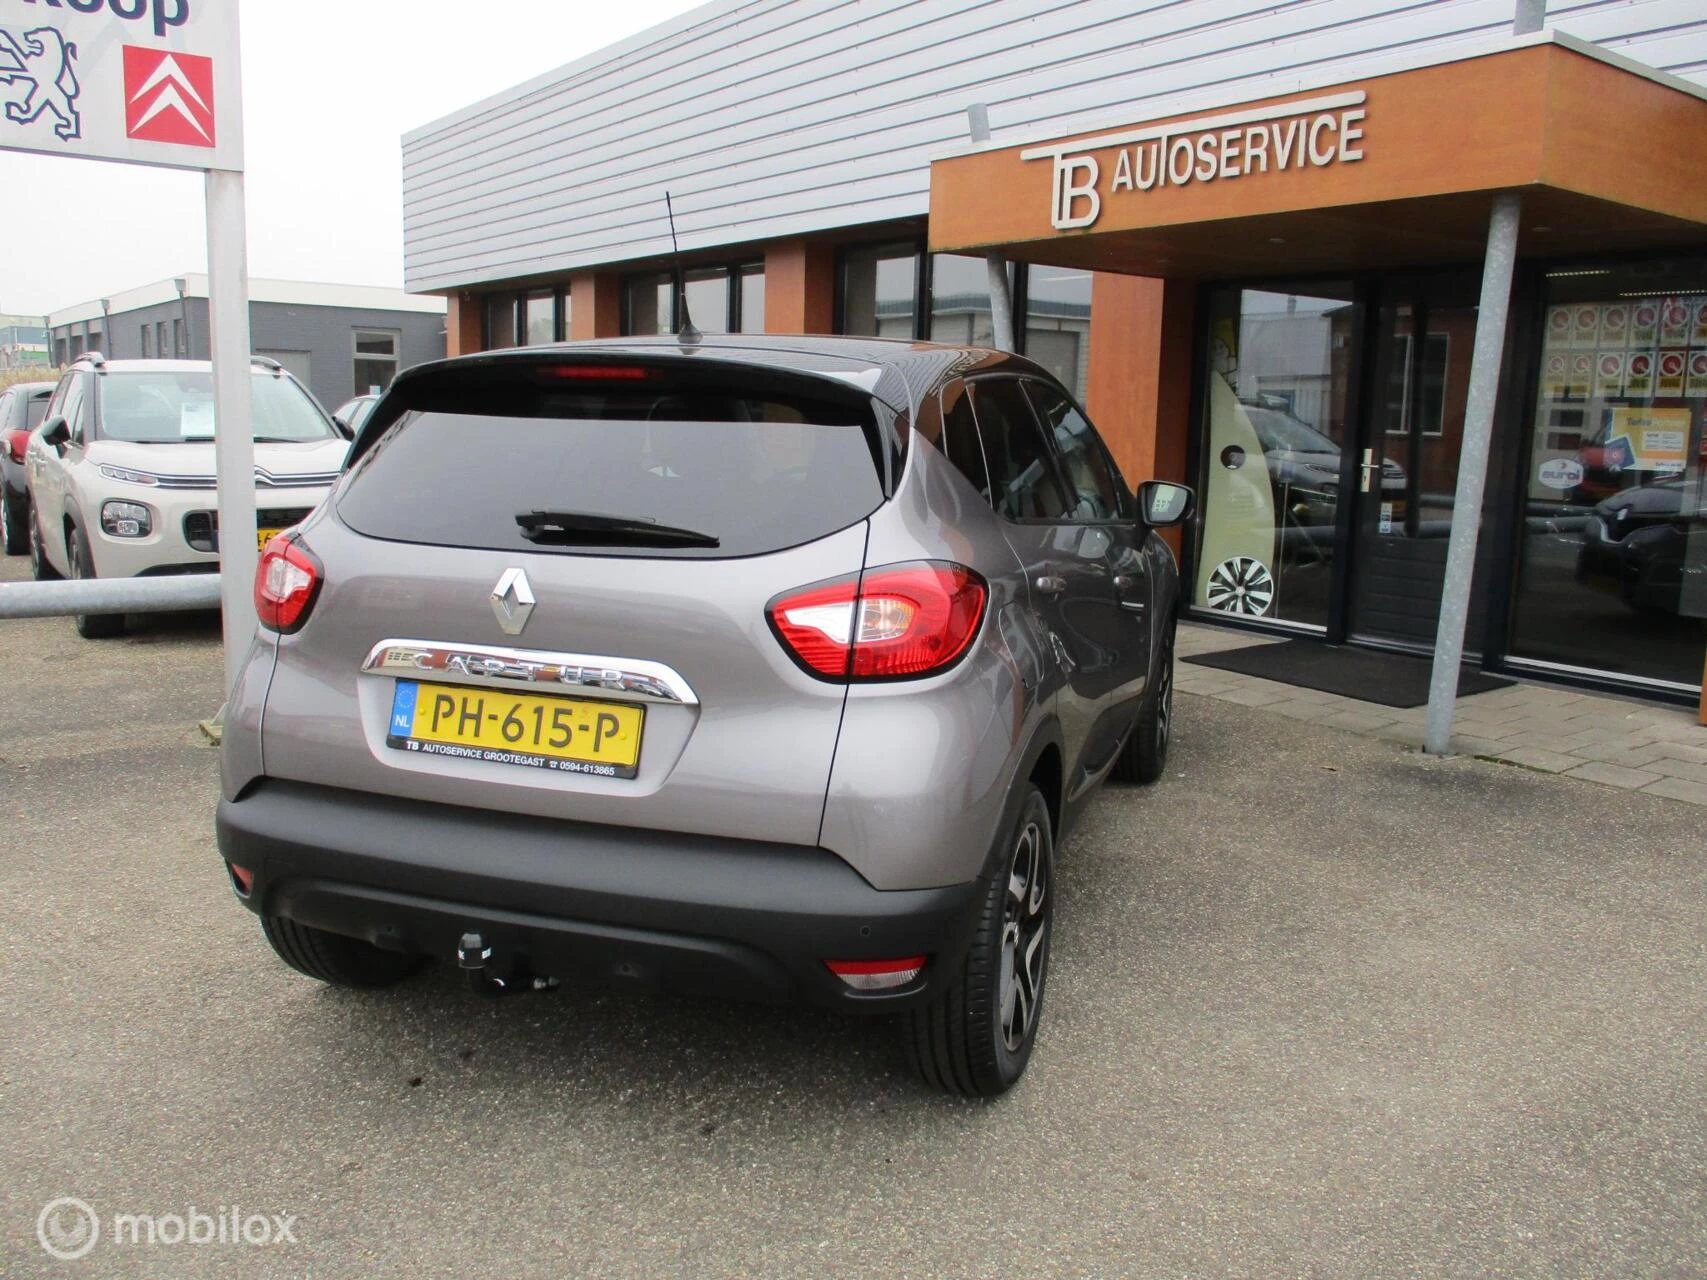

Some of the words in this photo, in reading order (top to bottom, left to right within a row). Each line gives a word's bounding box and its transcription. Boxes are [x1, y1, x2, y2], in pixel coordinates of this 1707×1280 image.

[1111, 109, 1366, 193] AUTOSERVICE
[413, 652, 626, 691] CAPTUR
[395, 713, 410, 728] NL
[431, 694, 620, 753] PH-615-P
[406, 740, 419, 751] TB
[422, 743, 482, 759] AUTOSERVICE
[483, 751, 545, 767] GROOTEGAST
[560, 761, 615, 776] 0594-613865
